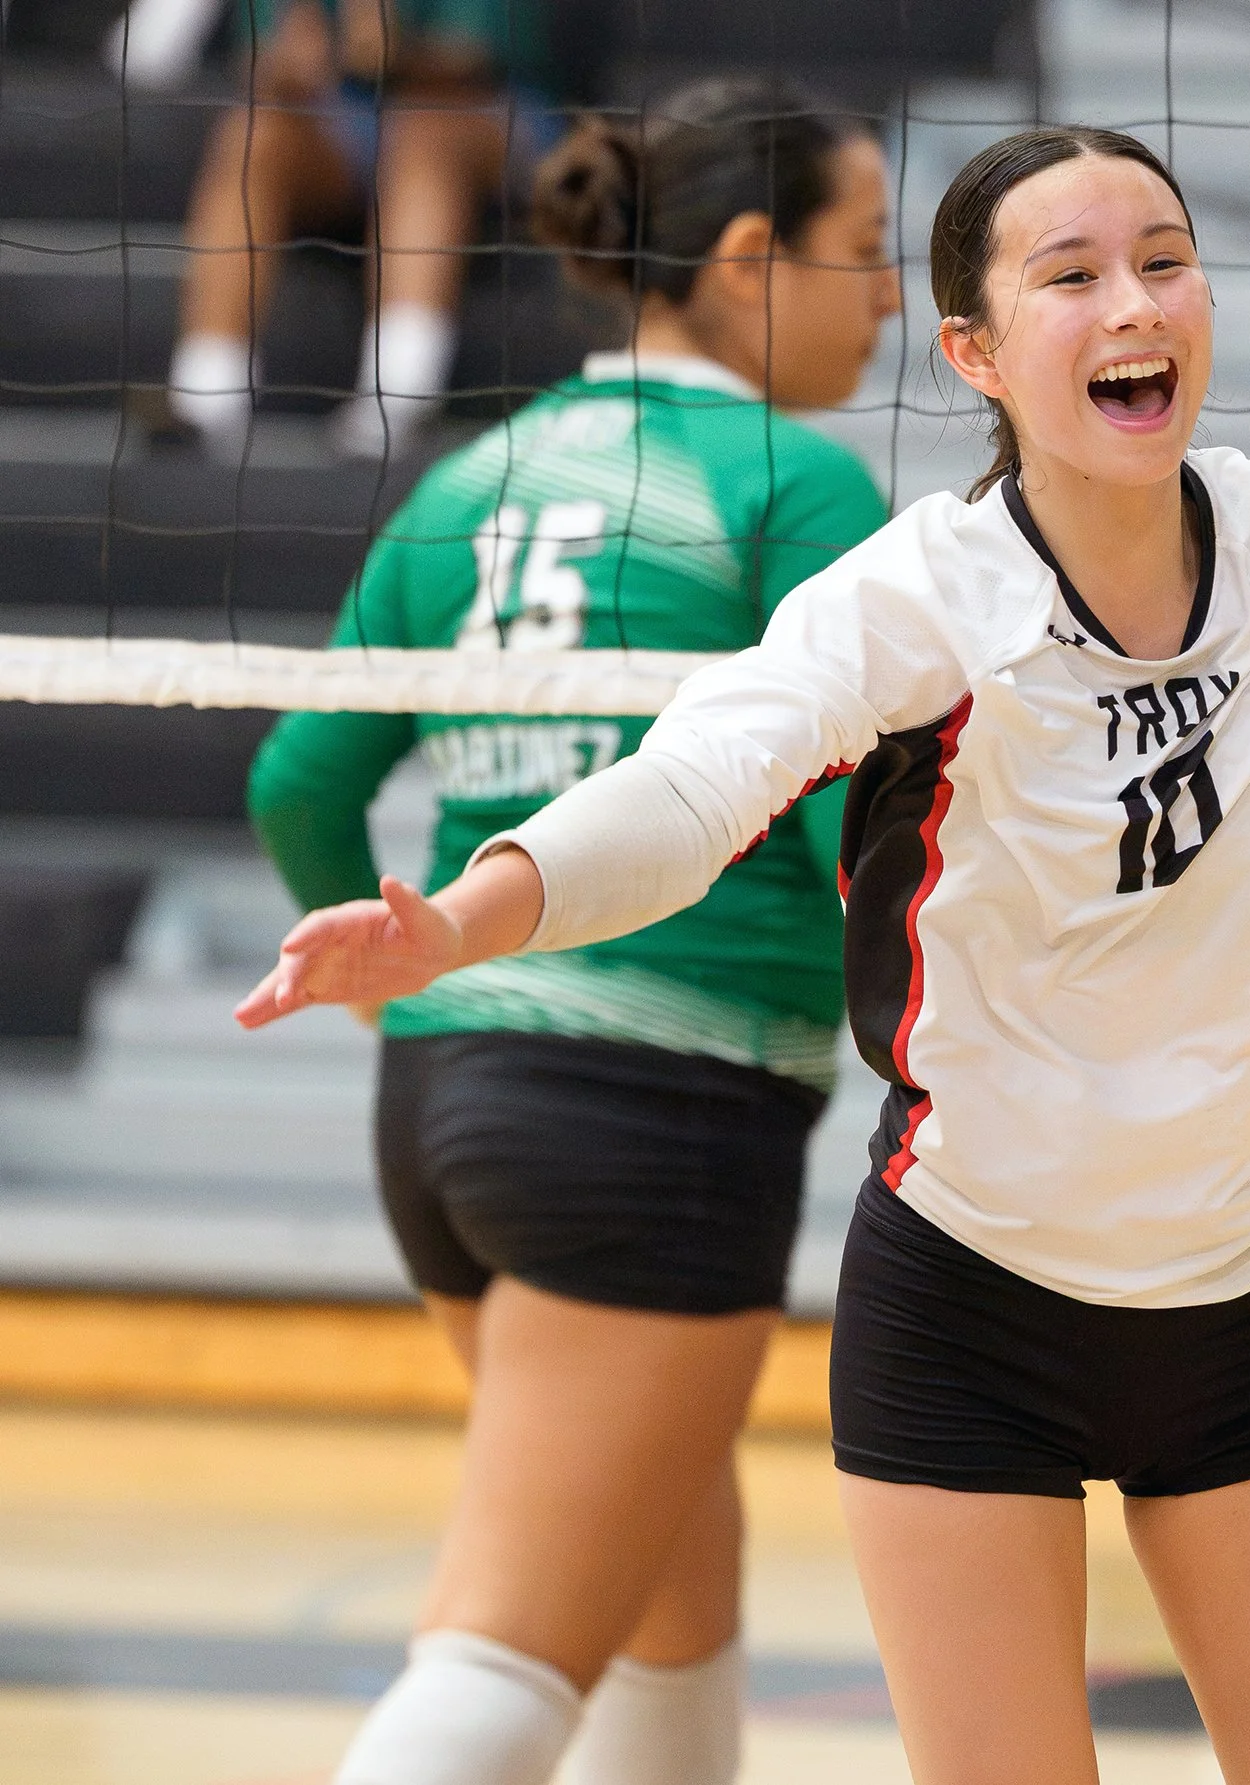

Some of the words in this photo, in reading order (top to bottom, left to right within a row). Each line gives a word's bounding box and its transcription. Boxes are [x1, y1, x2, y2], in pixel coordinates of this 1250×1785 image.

[456, 502, 606, 650] 15
[1097, 671, 1240, 762] TROY
[1116, 729, 1223, 894] 10
